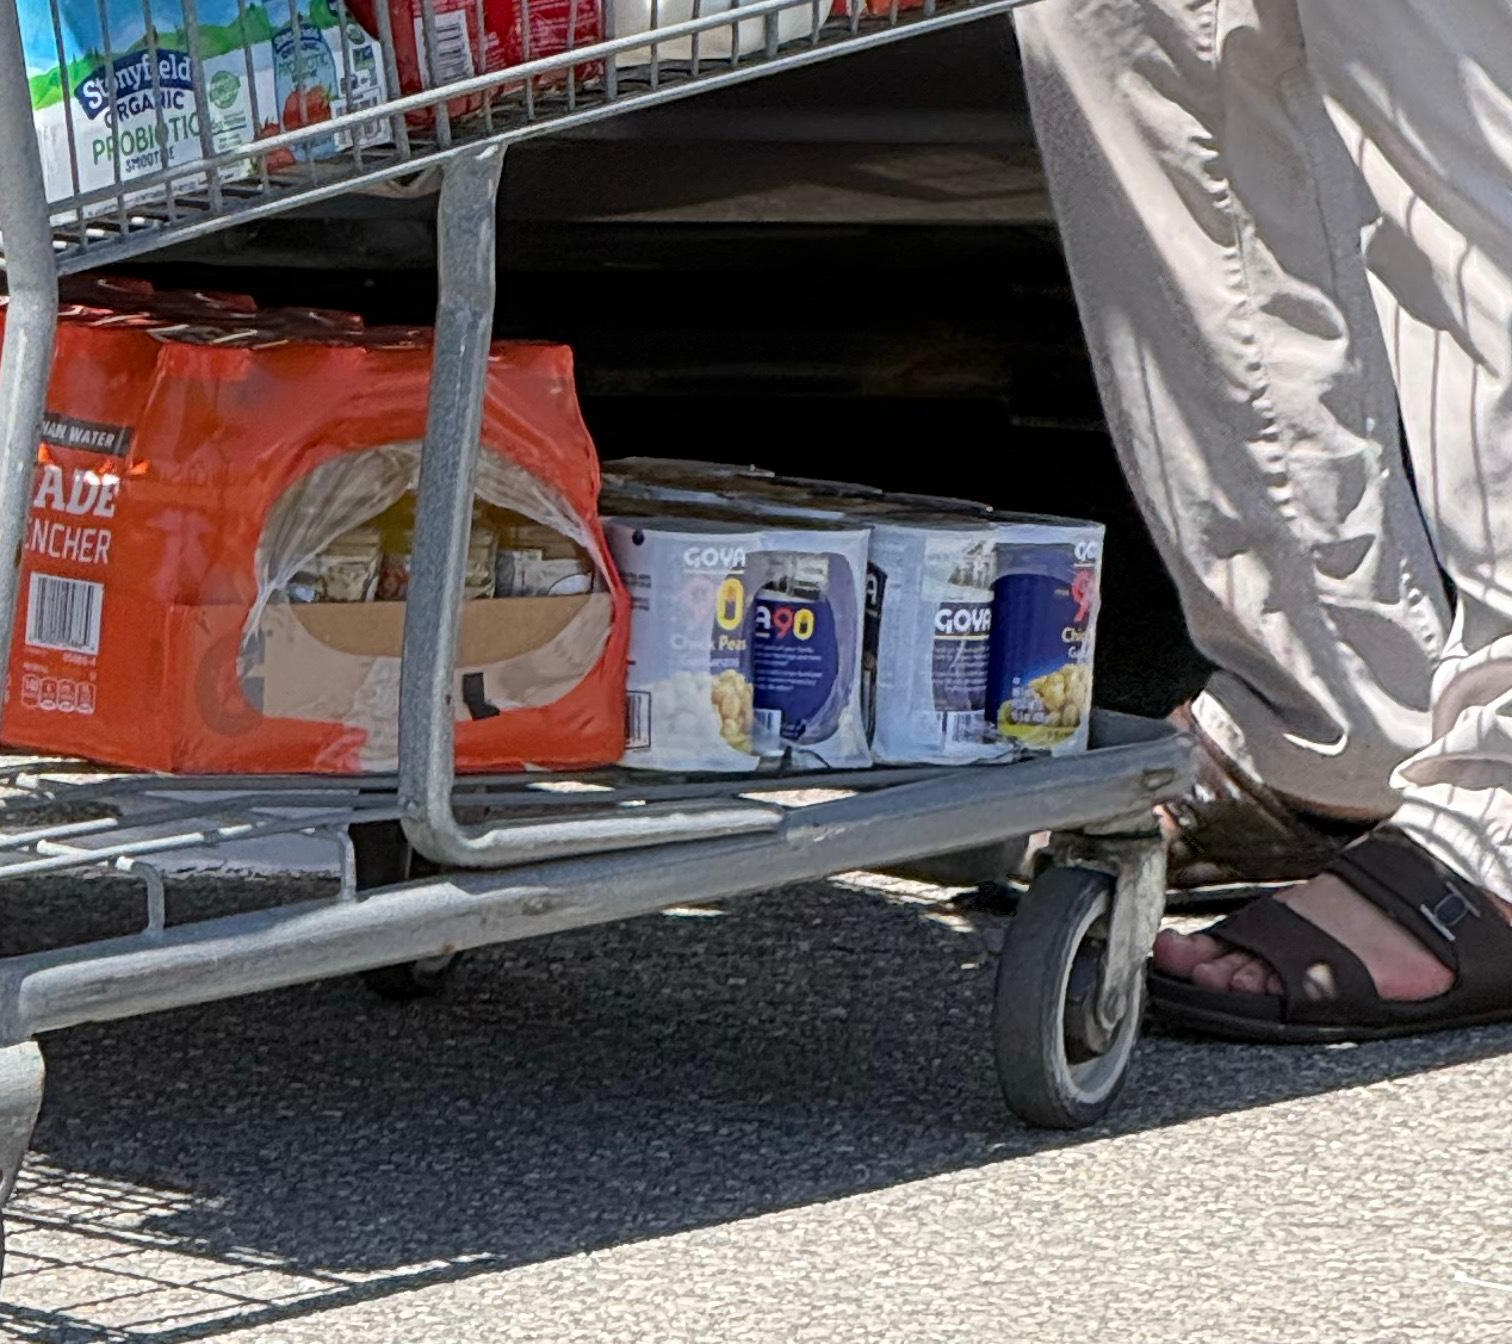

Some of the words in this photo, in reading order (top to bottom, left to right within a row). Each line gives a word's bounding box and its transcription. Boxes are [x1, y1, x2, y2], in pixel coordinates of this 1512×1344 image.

[69, 425, 116, 449] WATER
[683, 546, 746, 569] GOYA
[773, 606, 815, 641] 90
[934, 608, 992, 635] GOYA
